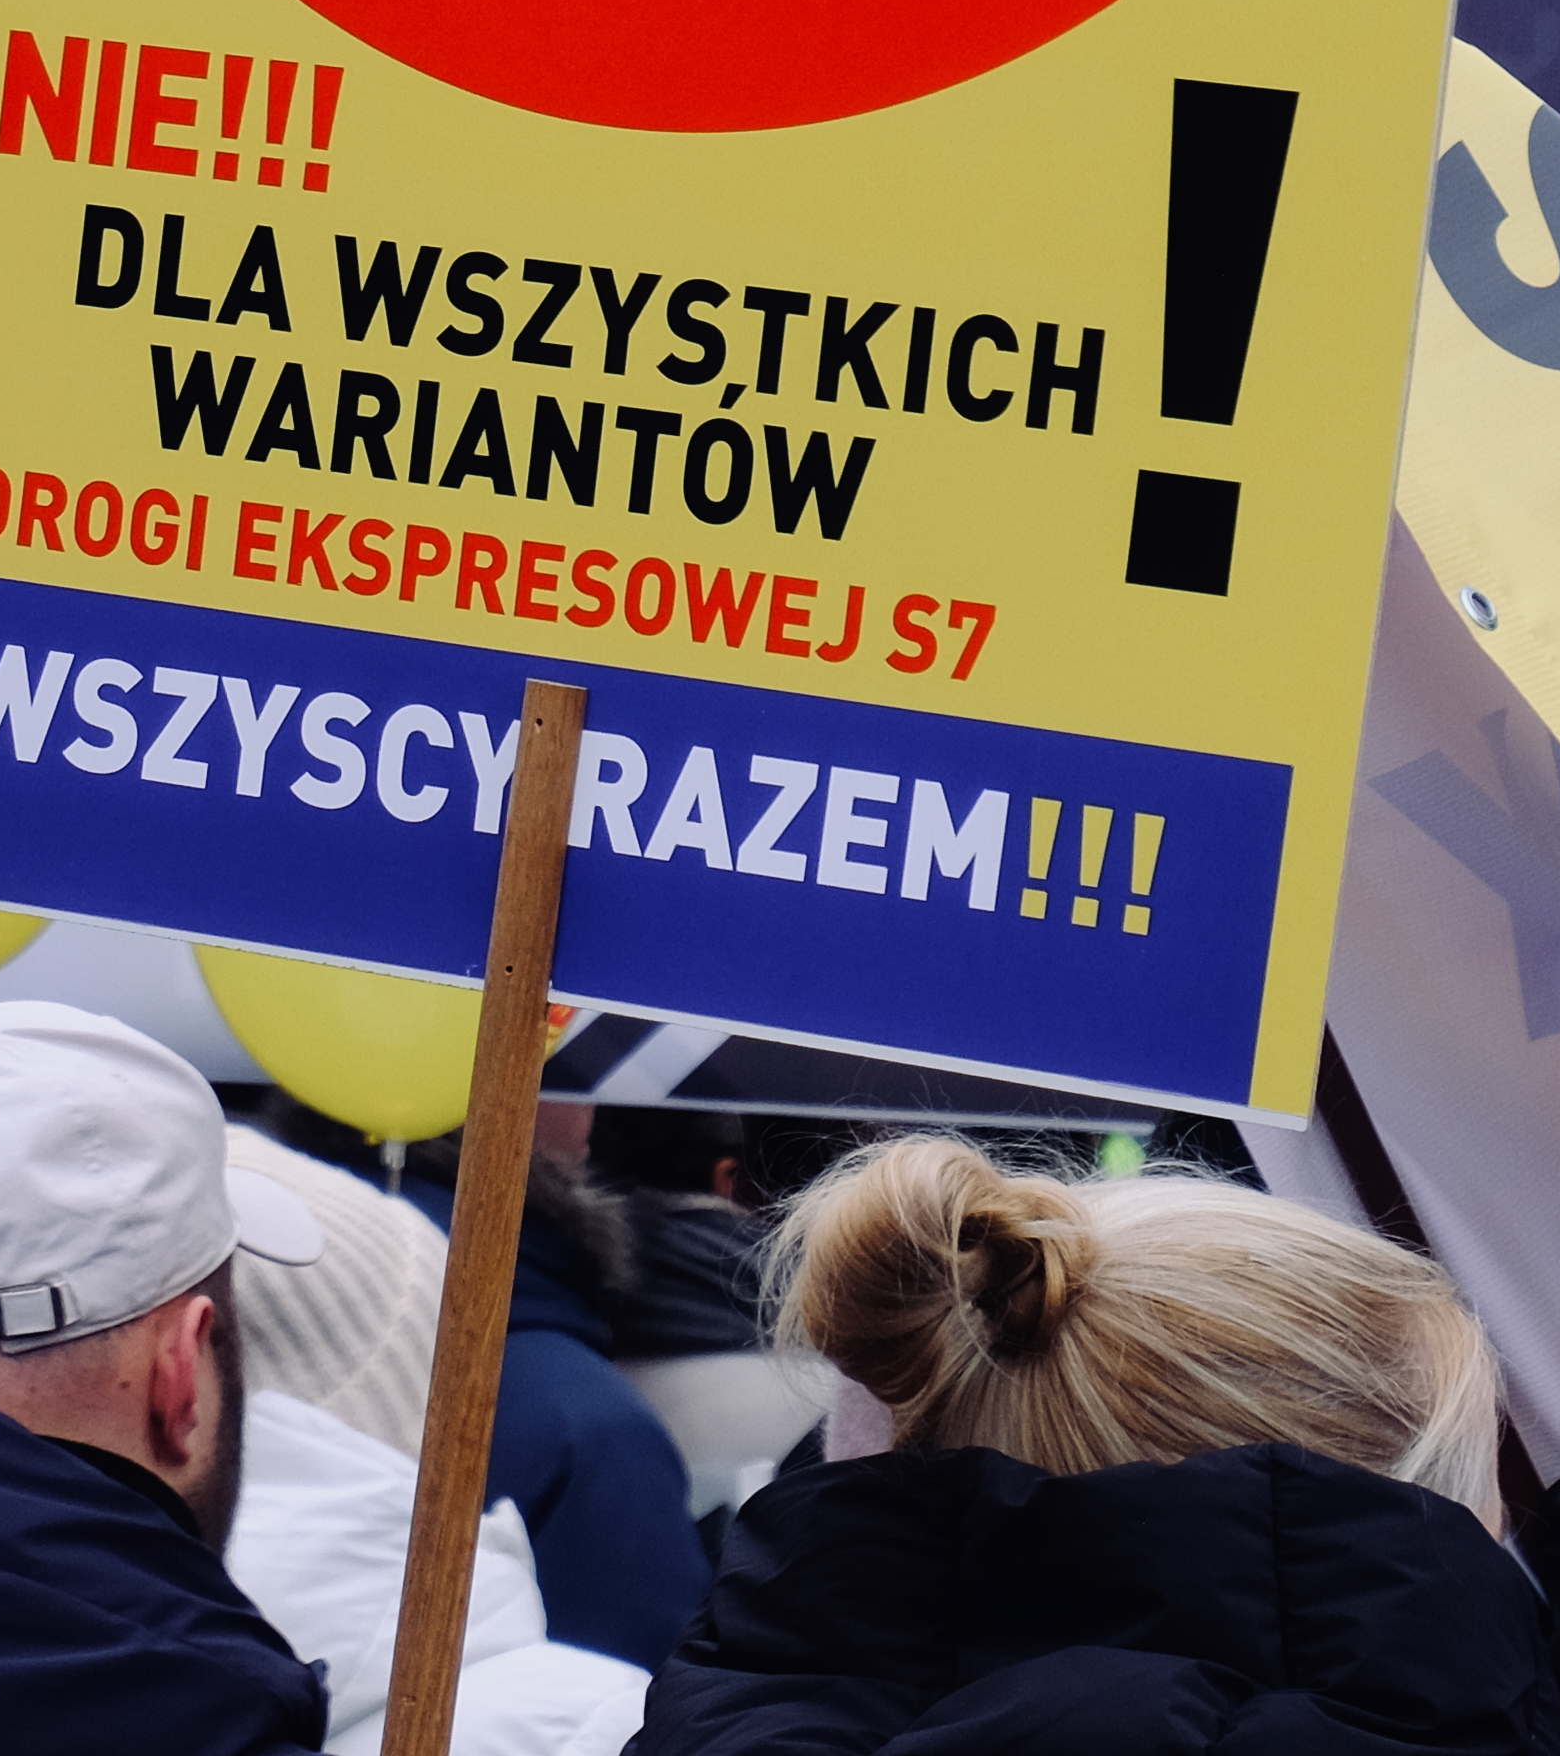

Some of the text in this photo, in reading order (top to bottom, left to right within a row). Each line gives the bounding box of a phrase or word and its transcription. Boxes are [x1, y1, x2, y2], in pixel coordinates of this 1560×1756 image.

[74, 204, 1107, 436] DLA WSZYSTKICH
[148, 344, 876, 543] WARIANTÓW
[234, 501, 868, 665] EKSPRESOWEJ
[886, 591, 999, 682] S7
[567, 730, 1168, 938] RAZEM!!!
